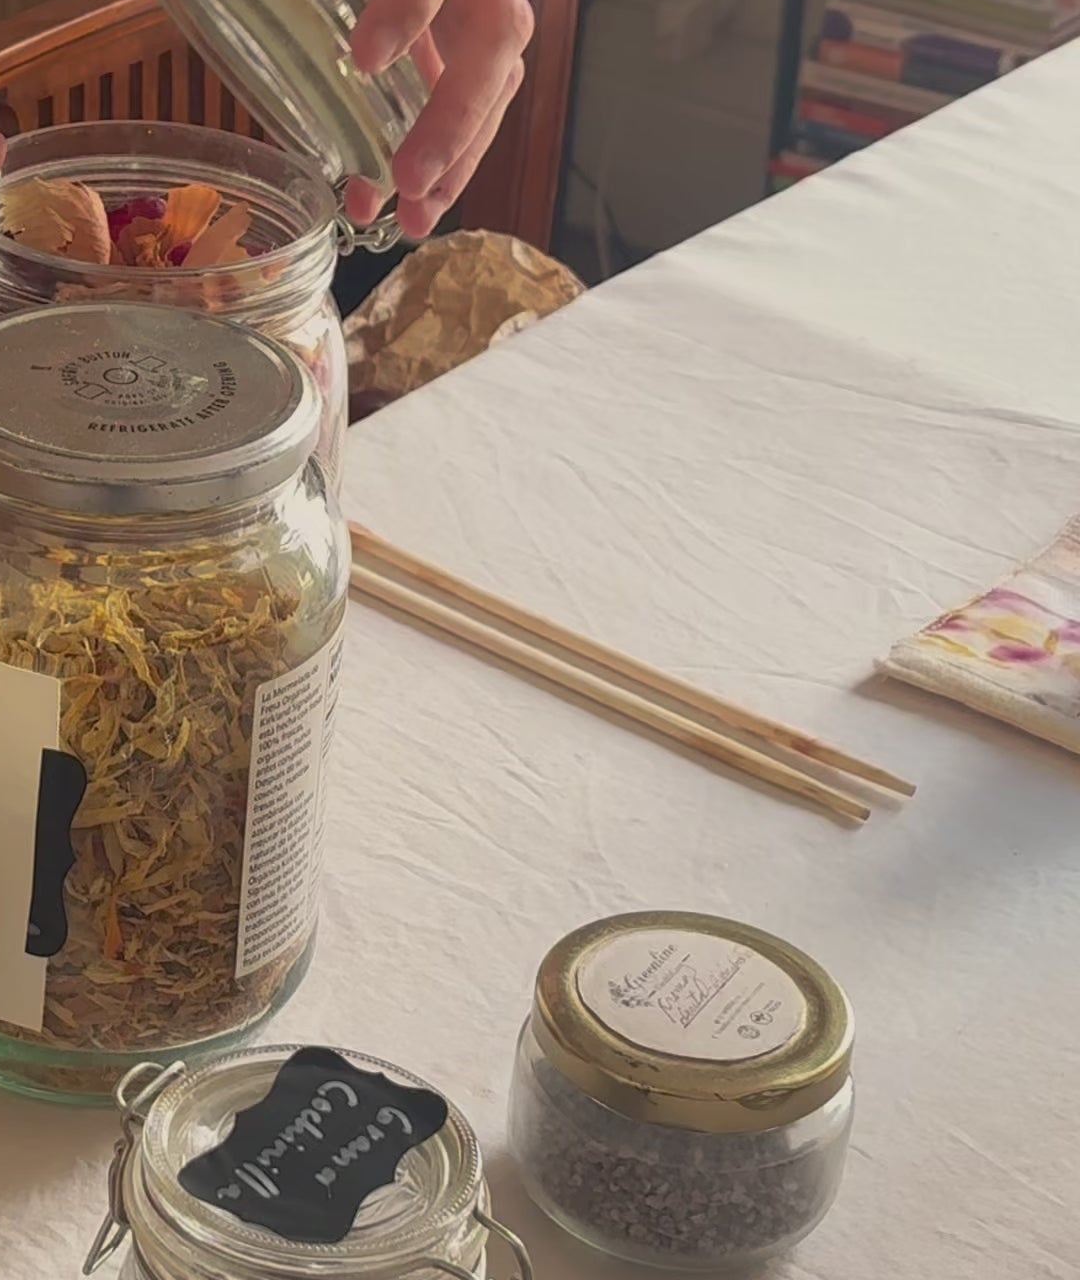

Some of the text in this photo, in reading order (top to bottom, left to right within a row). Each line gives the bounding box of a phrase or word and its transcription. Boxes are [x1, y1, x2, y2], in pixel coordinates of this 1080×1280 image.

[77, 351, 130, 365] BUTTON
[88, 416, 196, 434] REFRIGERATE
[195, 398, 230, 421] AFTER
[213, 361, 238, 398] OPENING
[217, 1080, 359, 1199] Cochinilla
